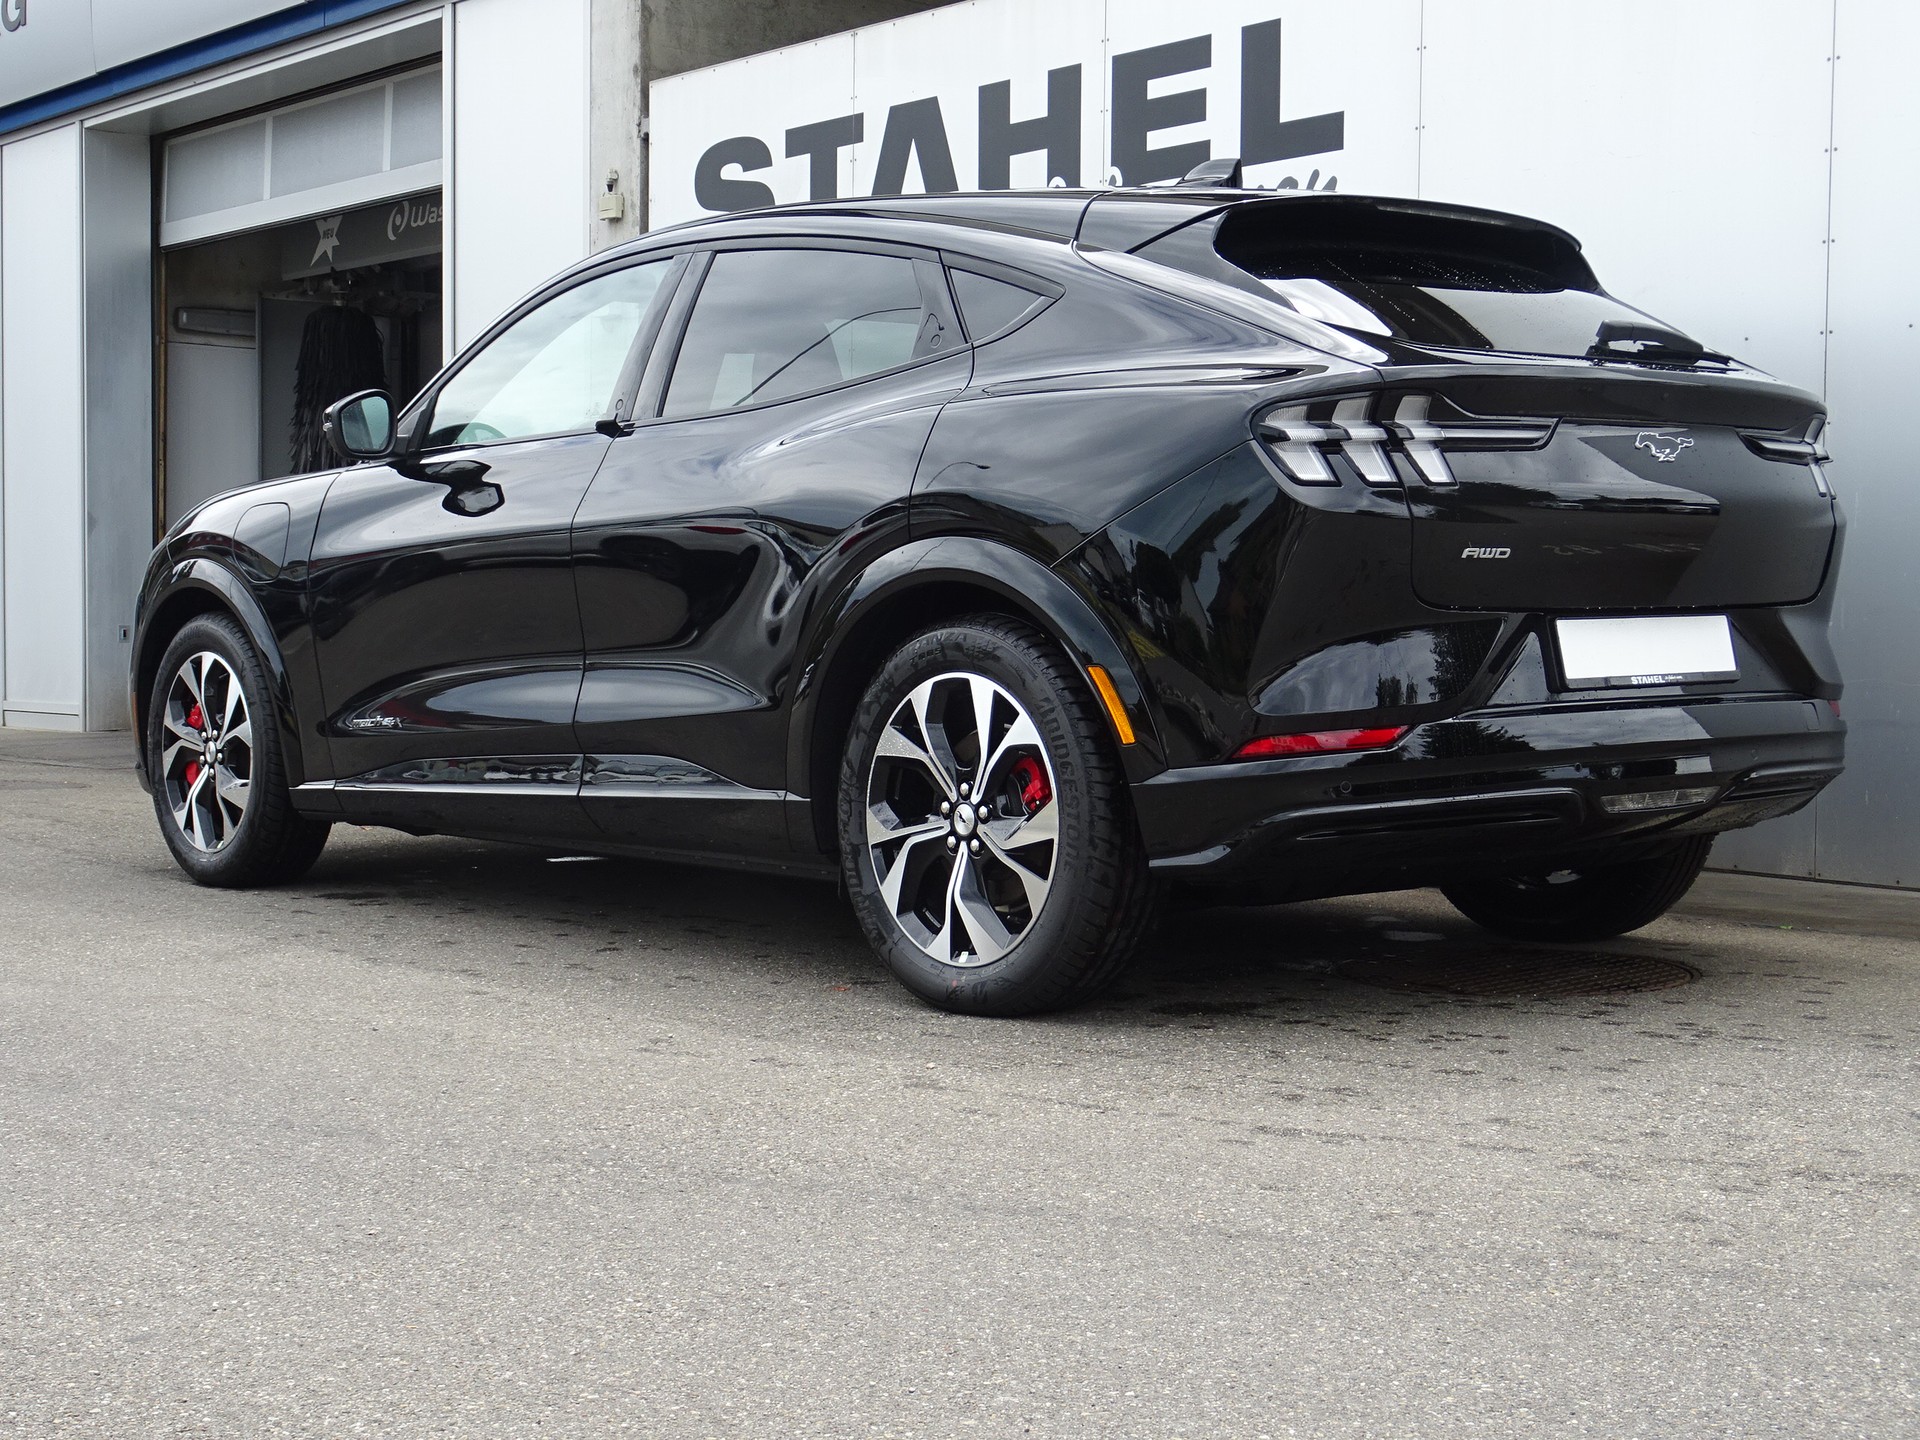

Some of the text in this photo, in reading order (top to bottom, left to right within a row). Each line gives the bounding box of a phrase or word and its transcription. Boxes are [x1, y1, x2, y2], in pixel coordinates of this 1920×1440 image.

[694, 18, 1344, 212] STAHEL
[1461, 547, 1512, 559] AWD
[1630, 674, 1666, 685] STAHEL
